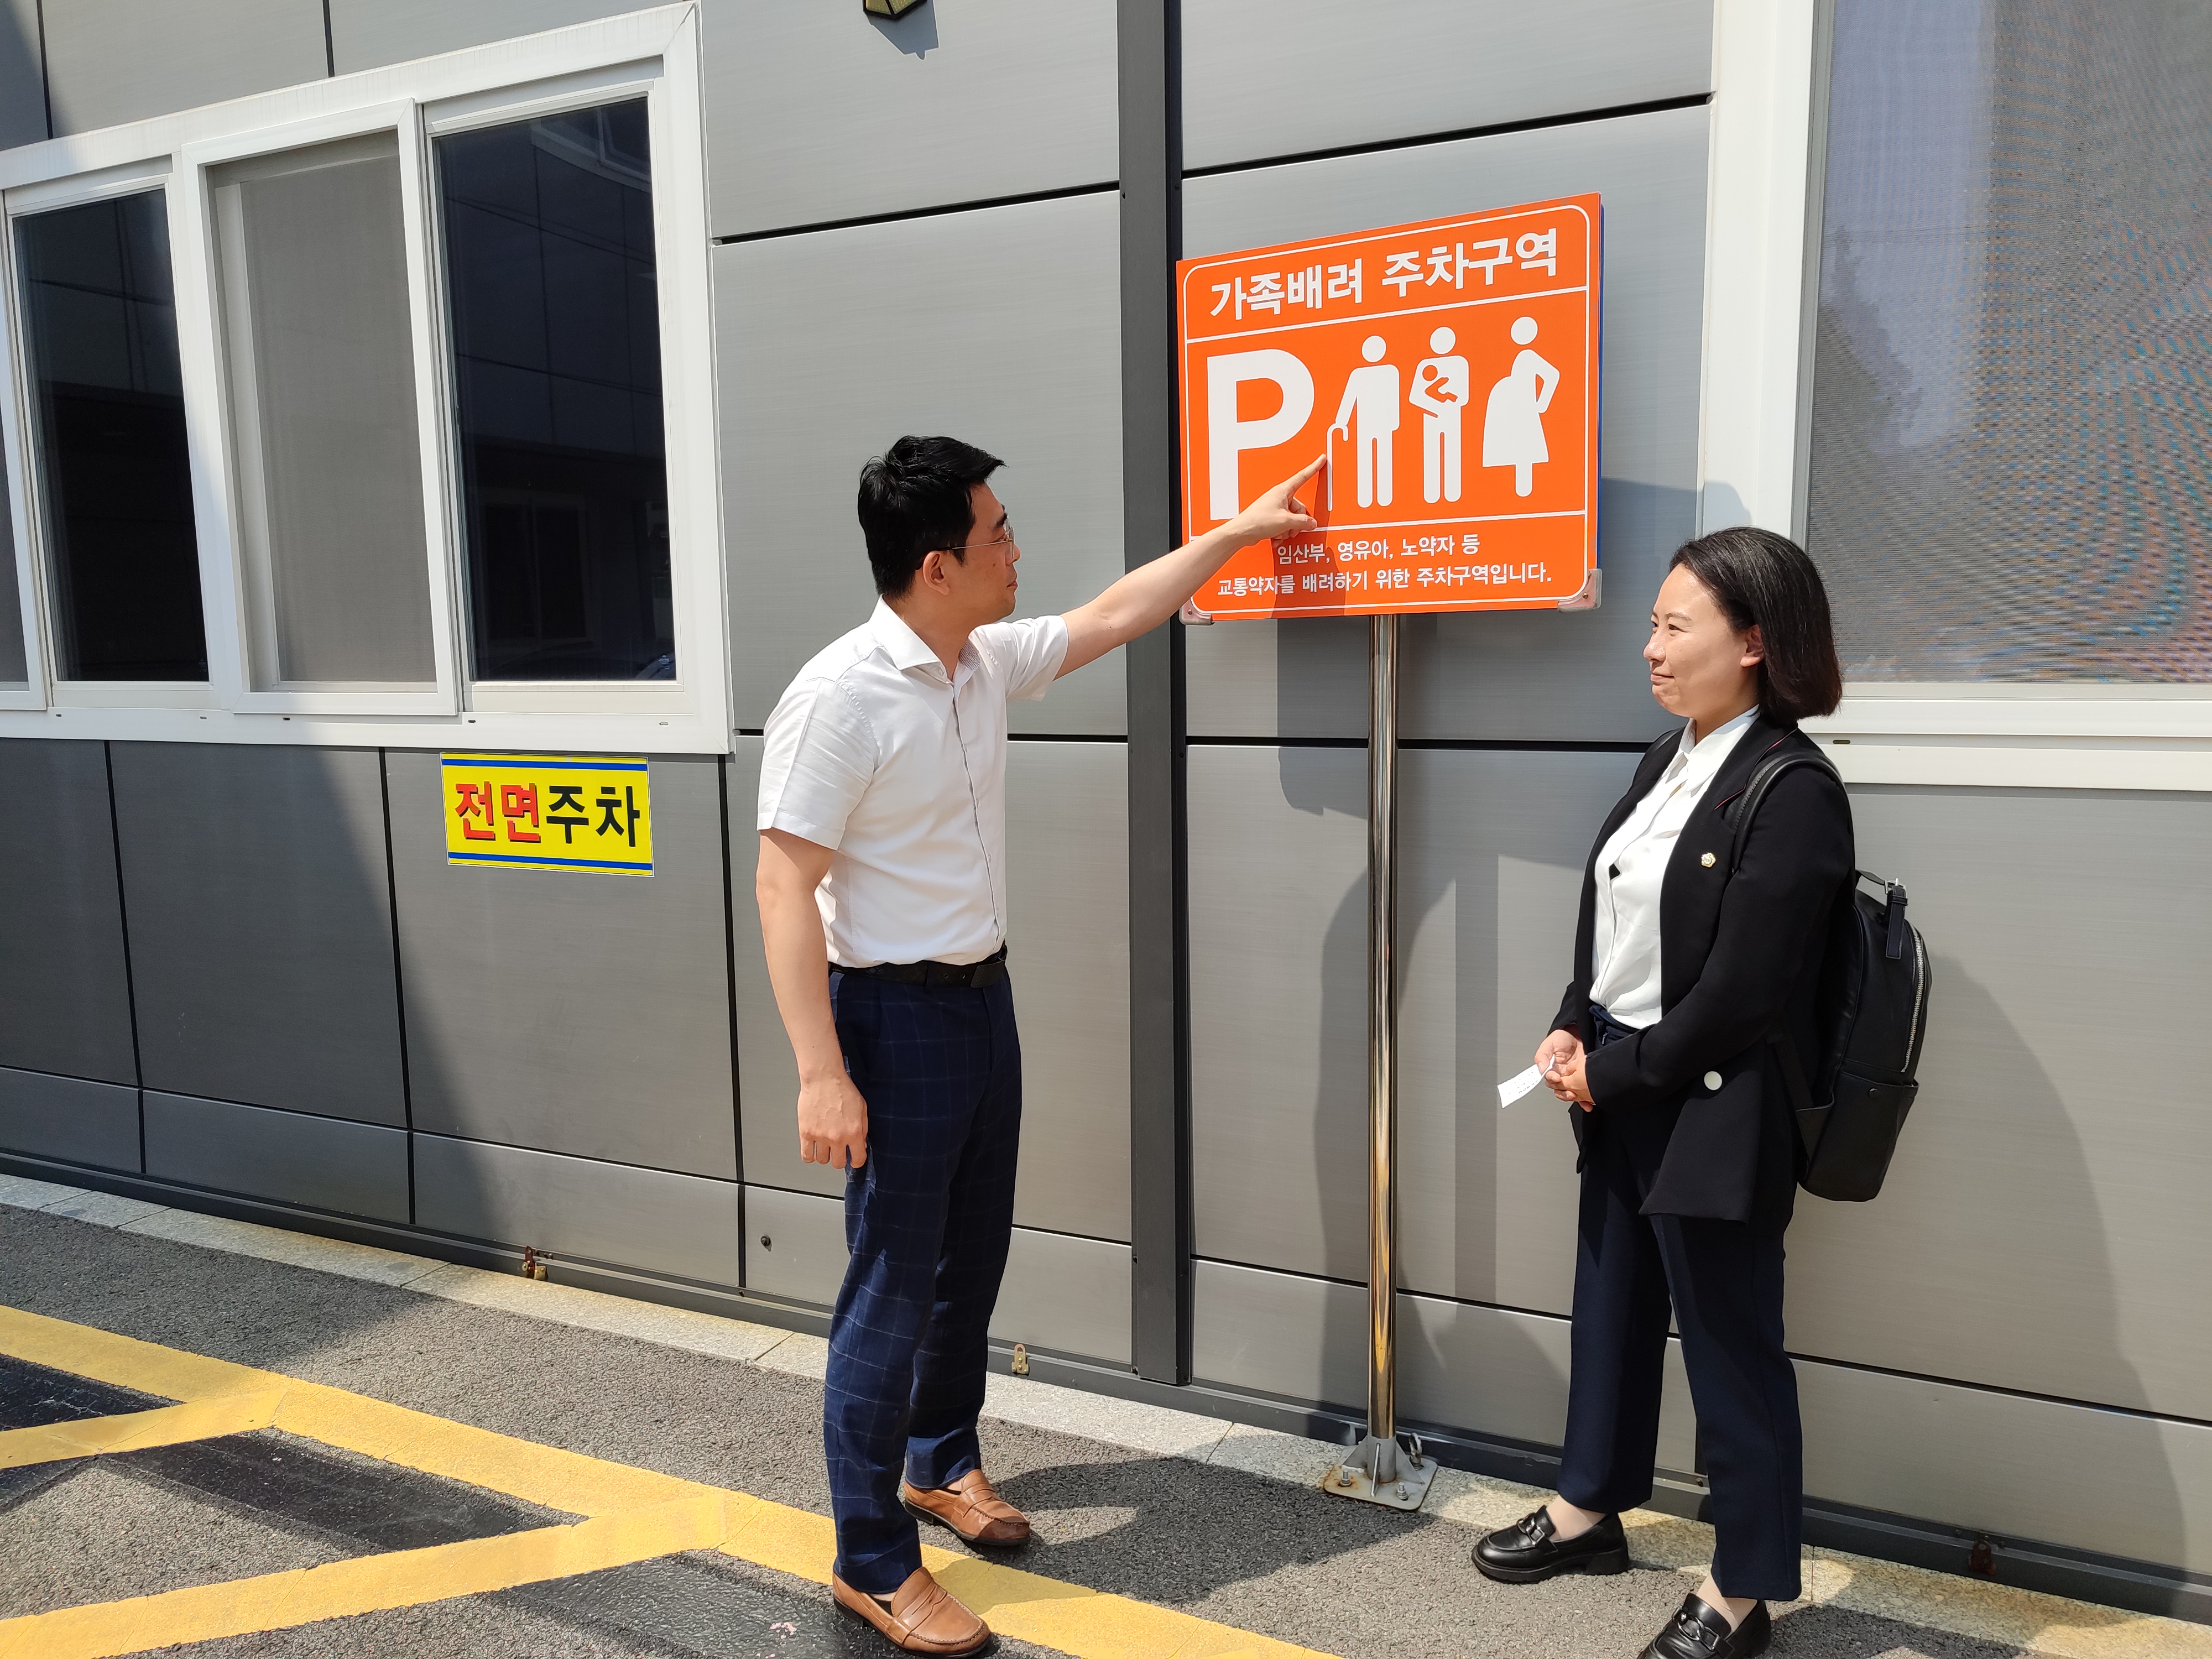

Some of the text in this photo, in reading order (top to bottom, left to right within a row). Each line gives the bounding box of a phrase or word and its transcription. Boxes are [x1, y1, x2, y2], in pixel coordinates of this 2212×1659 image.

[1210, 227, 1557, 321] 가족배려 주차구역
[1207, 349, 1315, 520] P
[1217, 561, 1552, 597] 교통약자를 배려하기 위한 주차구역입니다.
[1277, 534, 1481, 564] 임산부, 영유아, 노약자 등
[455, 781, 640, 847] 전면주차
